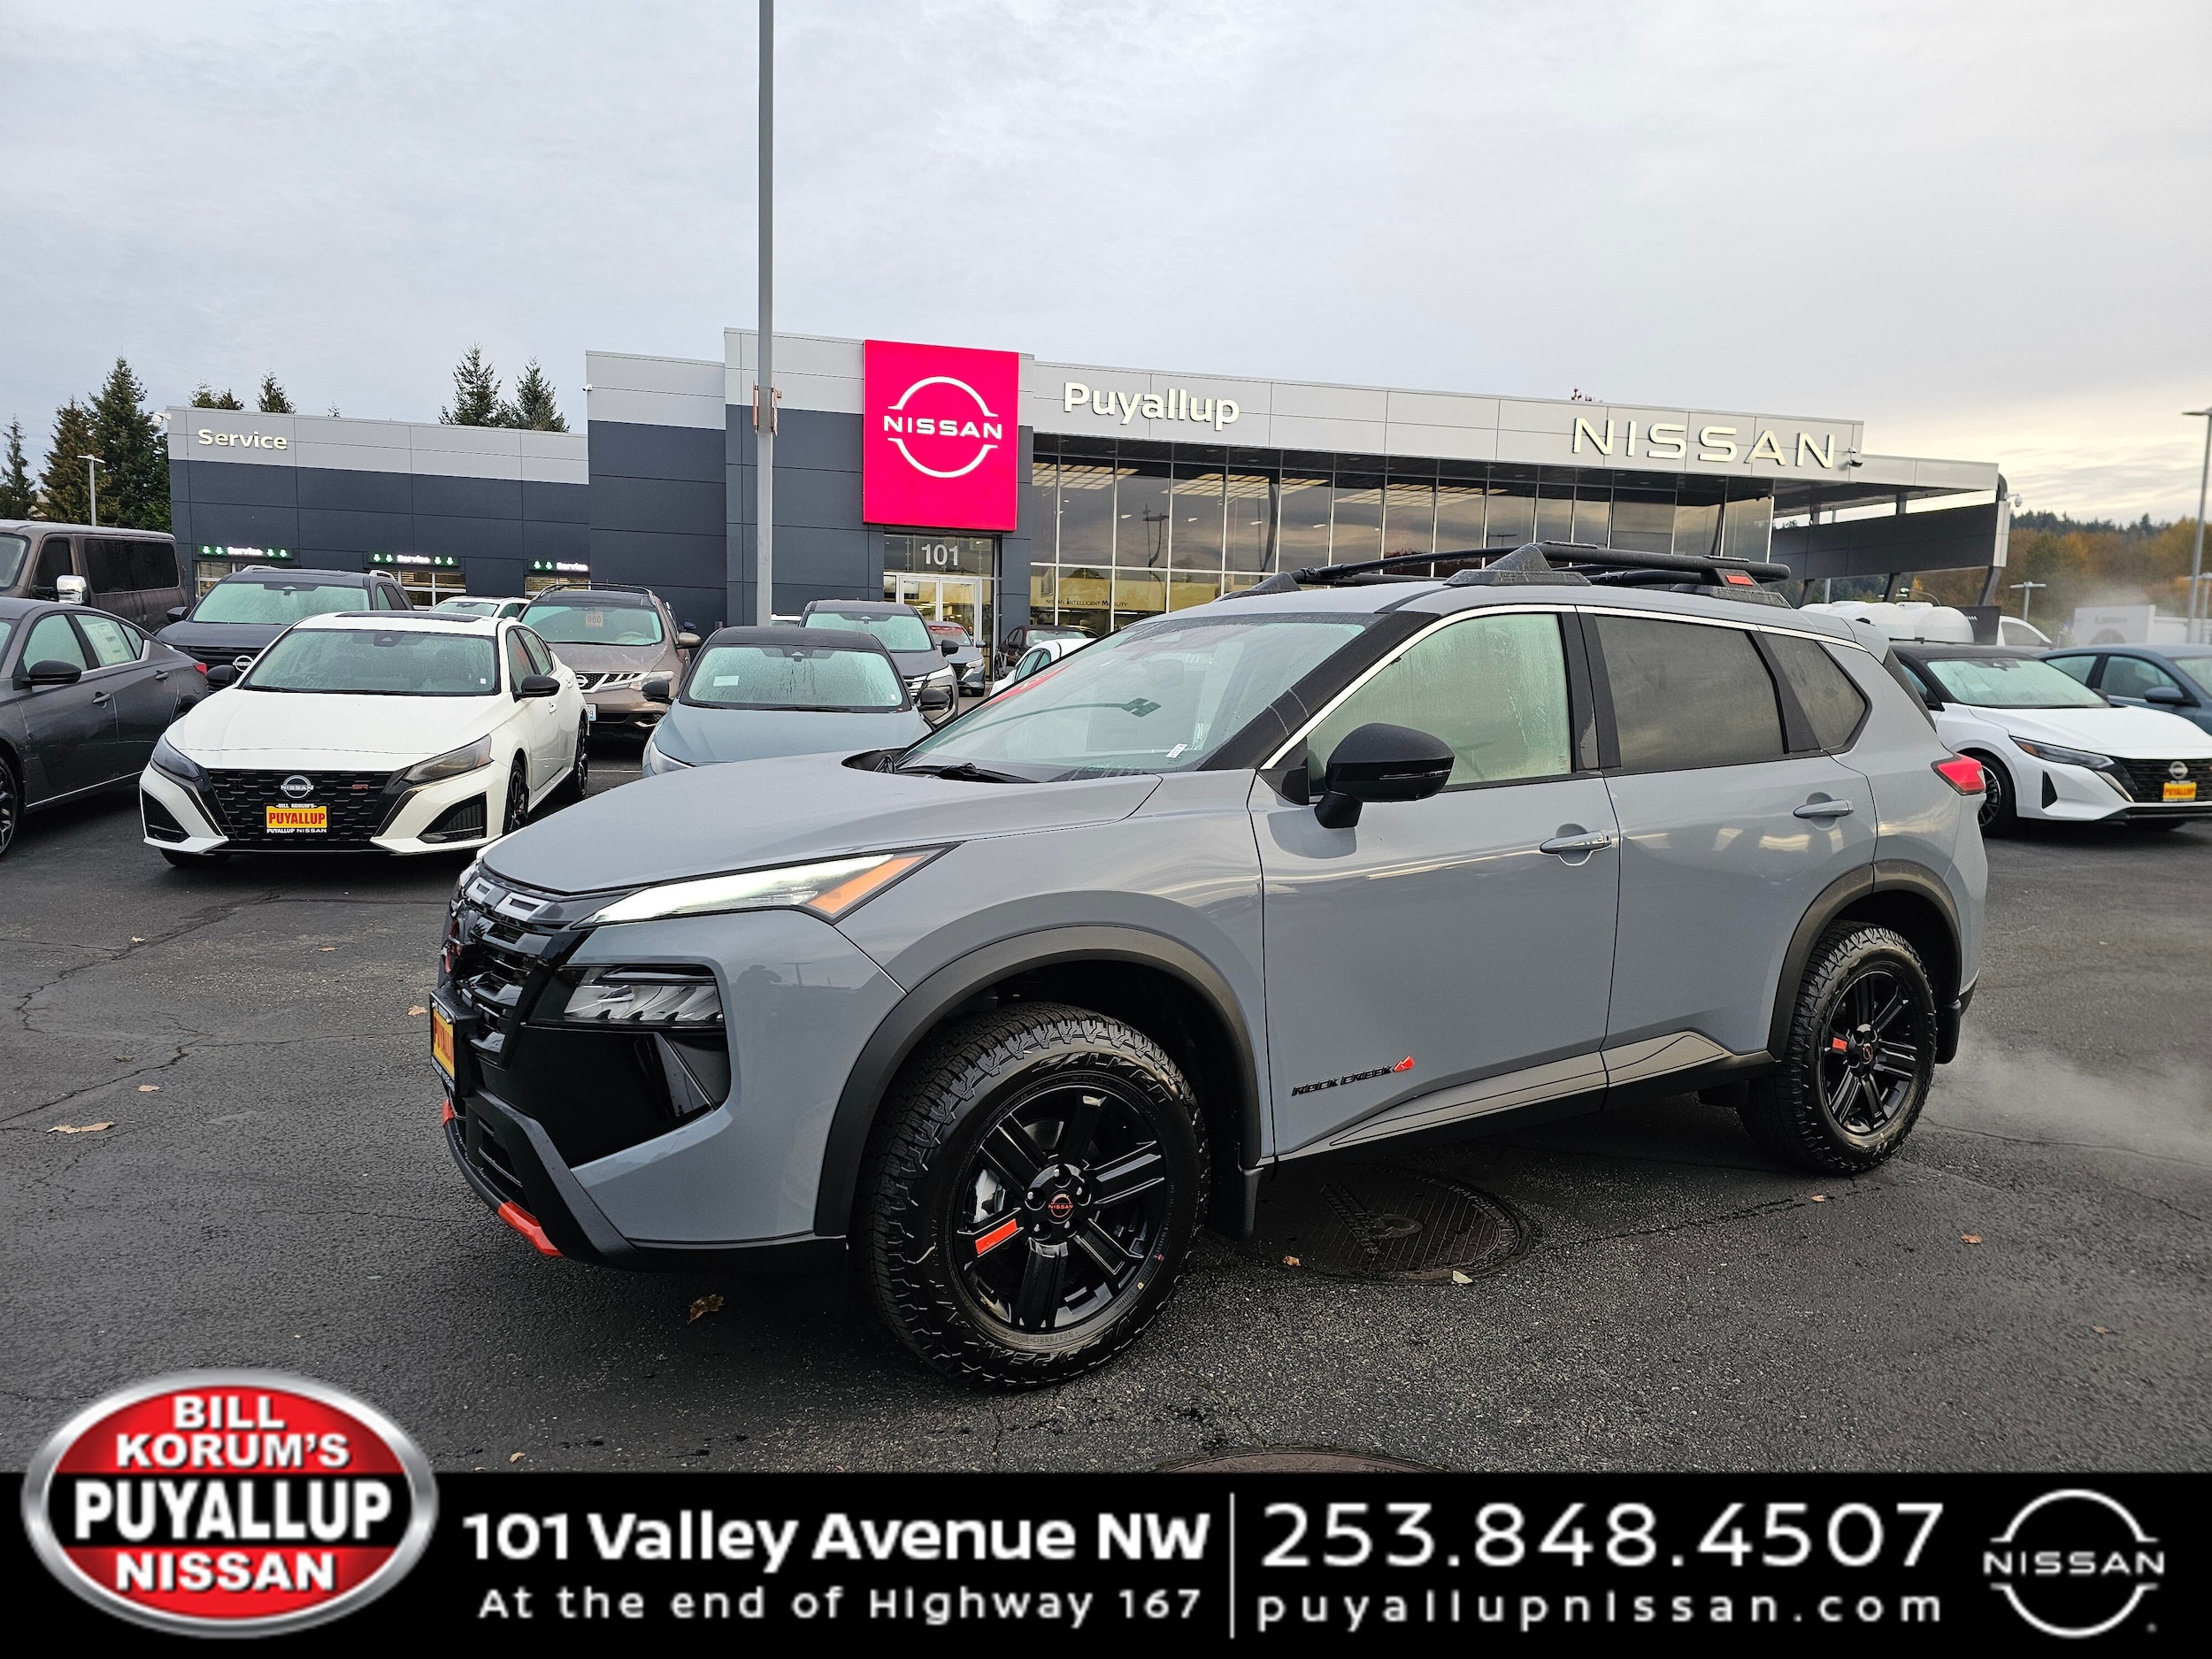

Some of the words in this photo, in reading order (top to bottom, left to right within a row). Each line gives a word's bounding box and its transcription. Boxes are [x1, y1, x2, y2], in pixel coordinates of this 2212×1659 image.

[1064, 381, 1240, 431] Puyallup
[198, 428, 288, 450] Service
[884, 415, 1002, 439] NISSAN
[1572, 417, 1835, 469] NISSAN
[921, 543, 958, 566] 101
[268, 812, 326, 825] PUYALLUP
[1291, 1077, 1340, 1097] ROCK
[1340, 1064, 1393, 1086] CREEK
